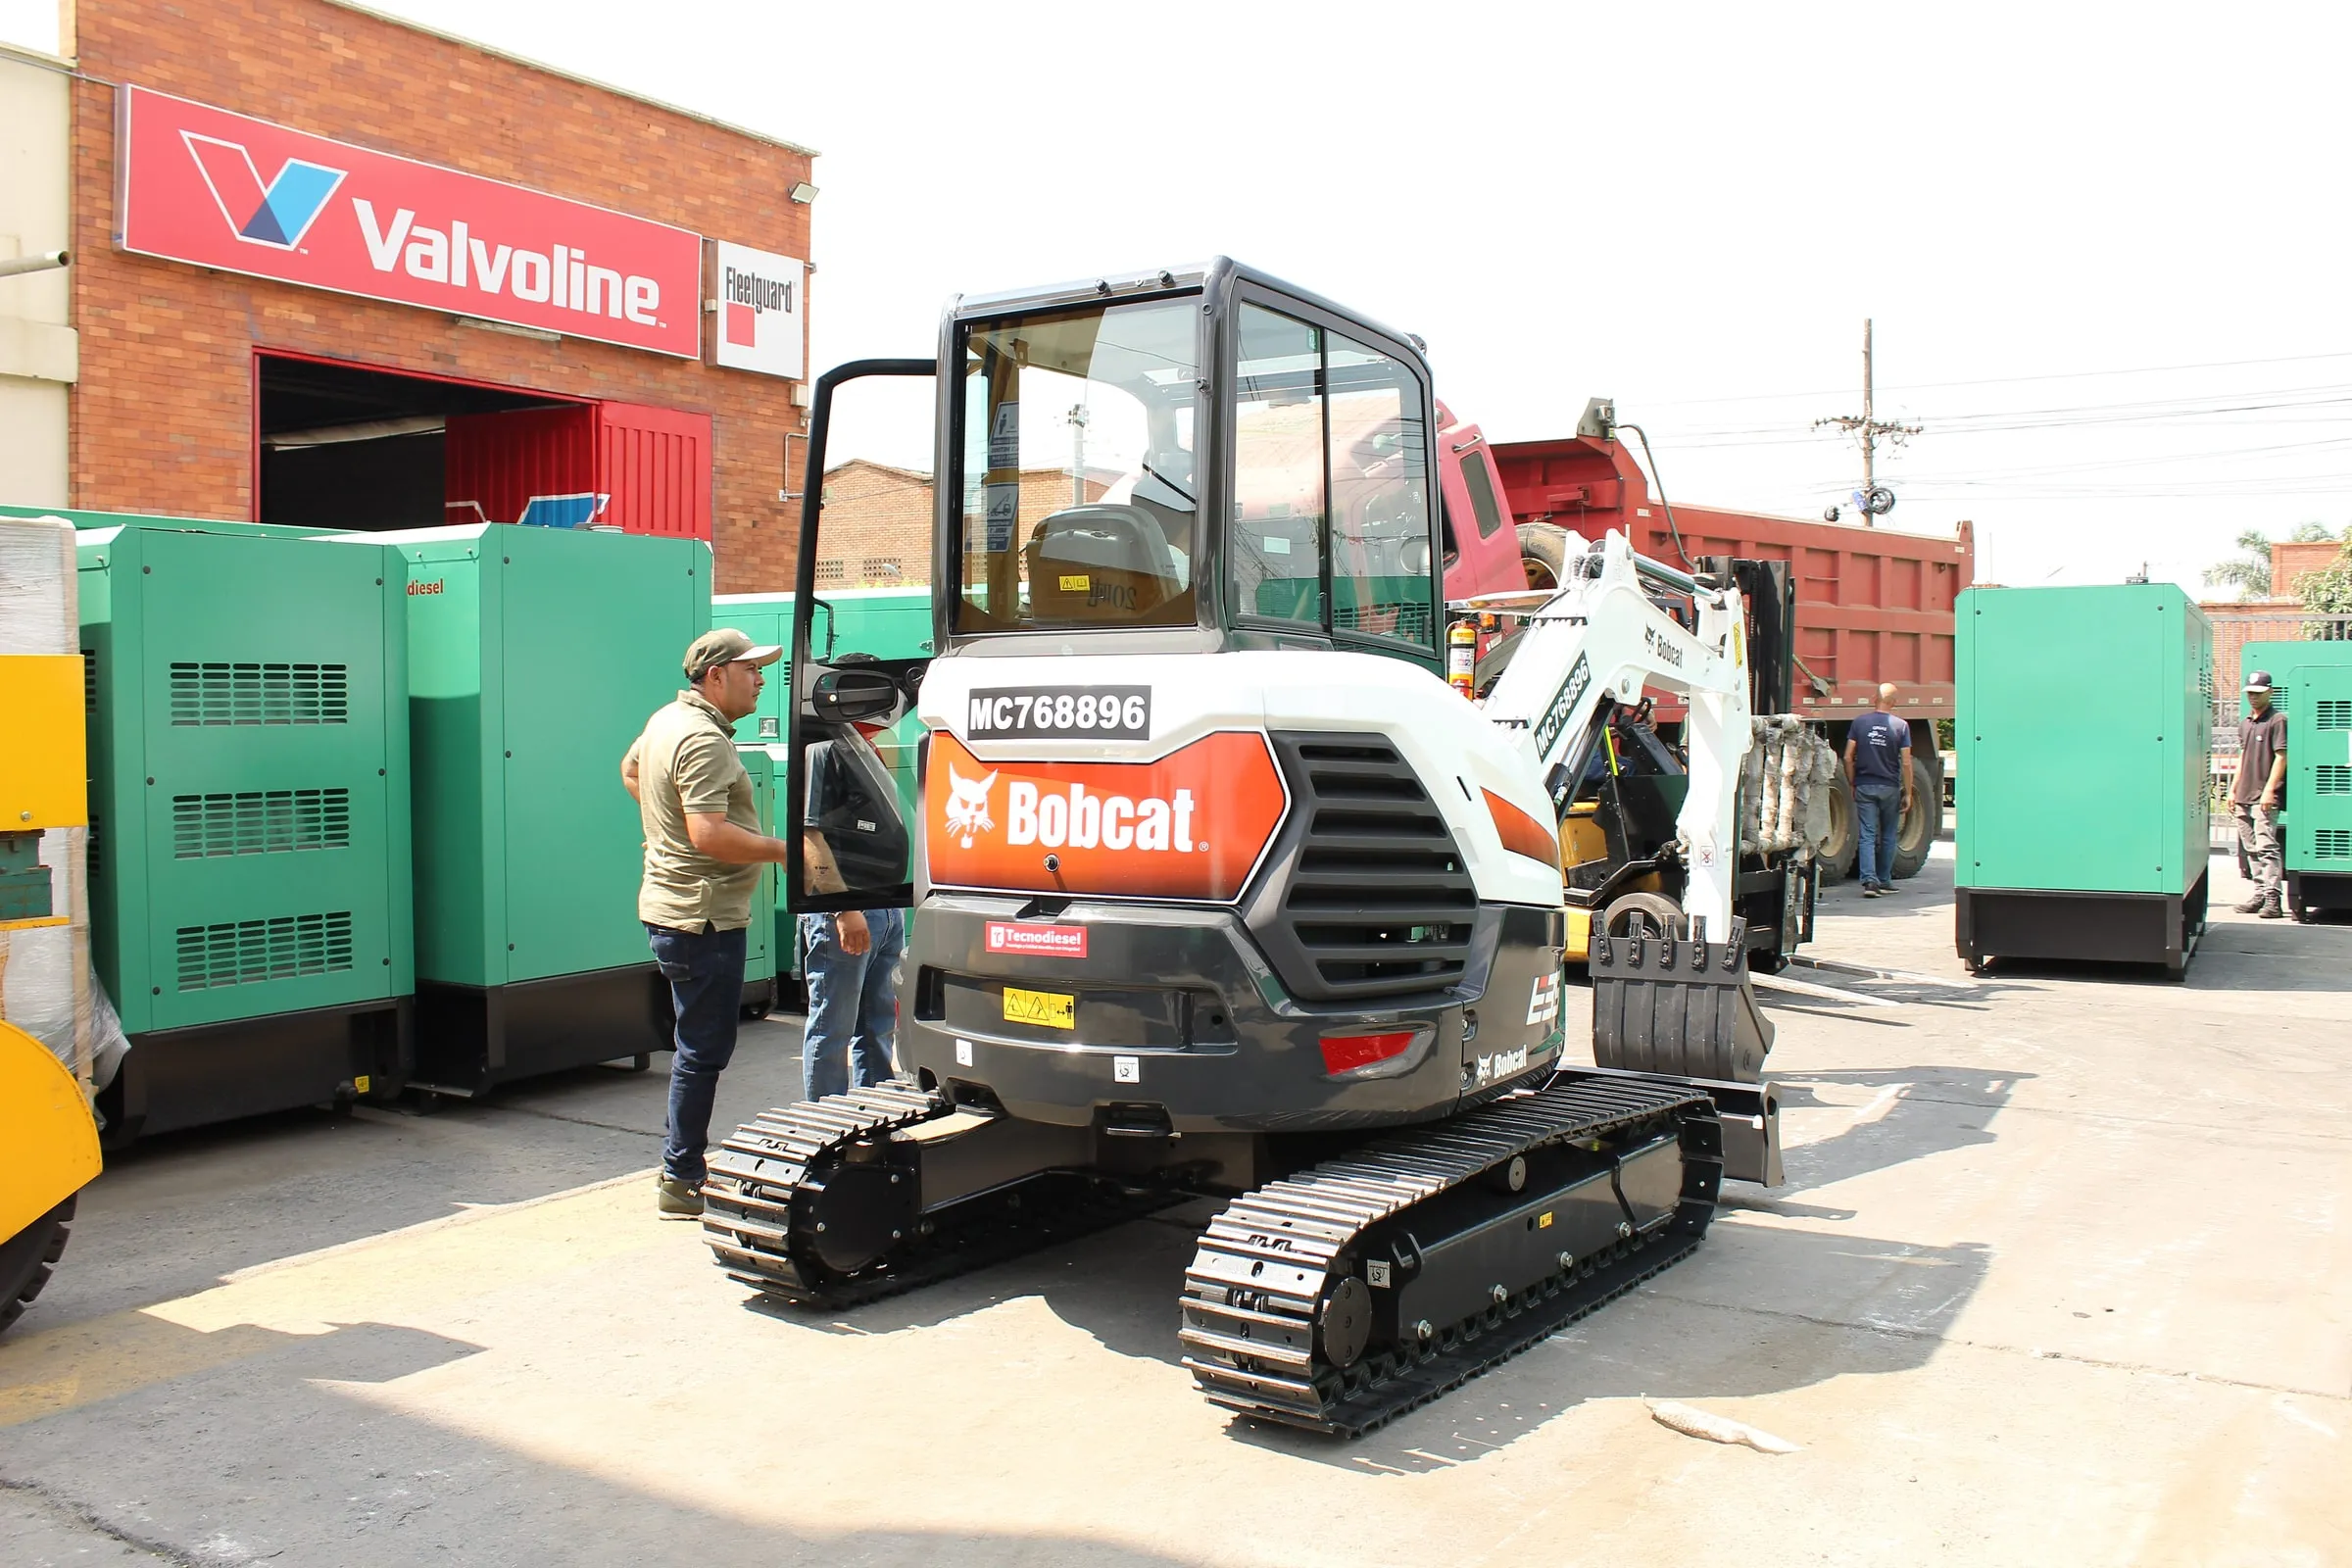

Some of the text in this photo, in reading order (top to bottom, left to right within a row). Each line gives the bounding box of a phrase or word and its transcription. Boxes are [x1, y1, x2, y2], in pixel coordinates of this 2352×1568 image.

[352, 197, 660, 326] Valvoline
[726, 267, 792, 314] Fleetguard
[407, 578, 443, 596] diesel
[1657, 634, 1683, 668] Bobcat
[970, 695, 1146, 730] MC768896
[1535, 659, 1589, 757] MC768896
[1007, 781, 1195, 853] Bobcat
[1005, 928, 1082, 946] Tecnodiesel
[1494, 1044, 1528, 1079] Bobcat
